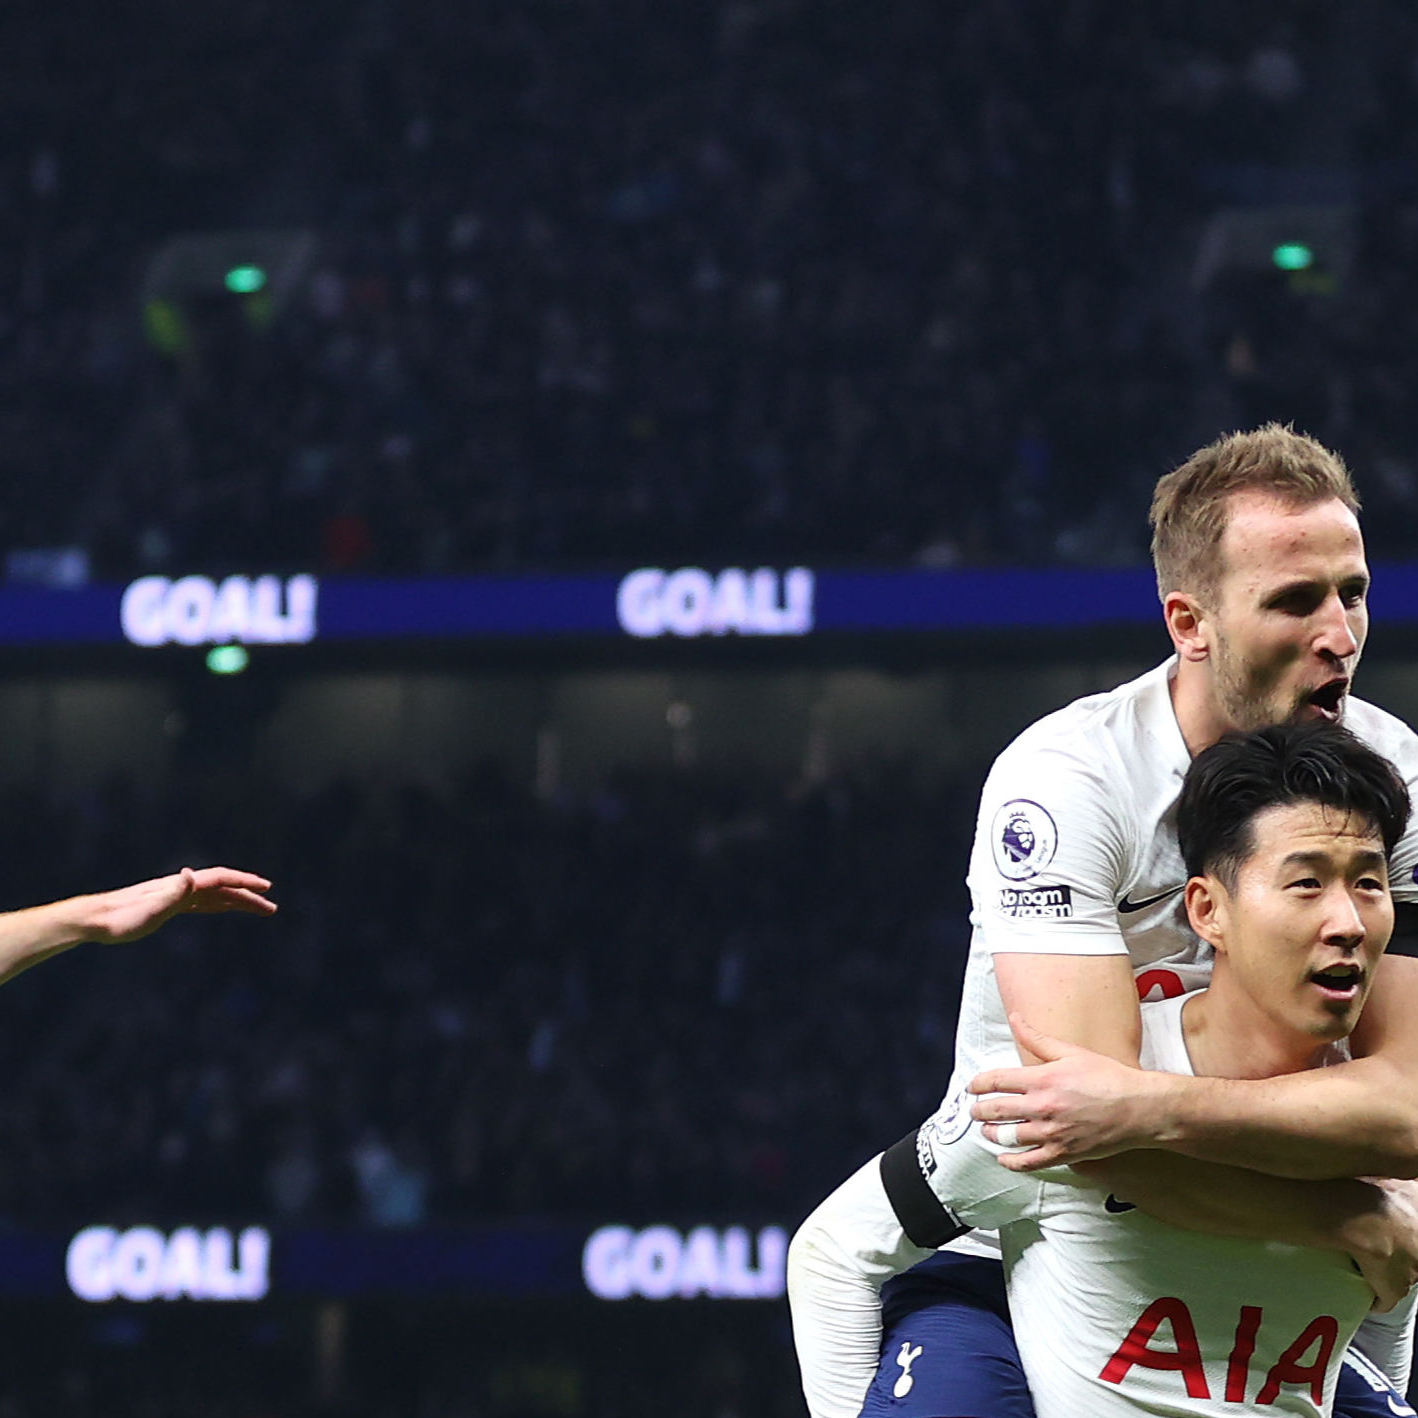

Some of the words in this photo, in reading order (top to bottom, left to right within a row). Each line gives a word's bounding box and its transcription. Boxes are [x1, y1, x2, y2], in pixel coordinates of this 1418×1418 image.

[120, 574, 317, 647] GOAL!
[616, 568, 814, 638] GOAL!
[66, 1226, 270, 1302] GOAL!
[583, 1226, 788, 1300] GOAL!
[1098, 1297, 1338, 1406] AIA
